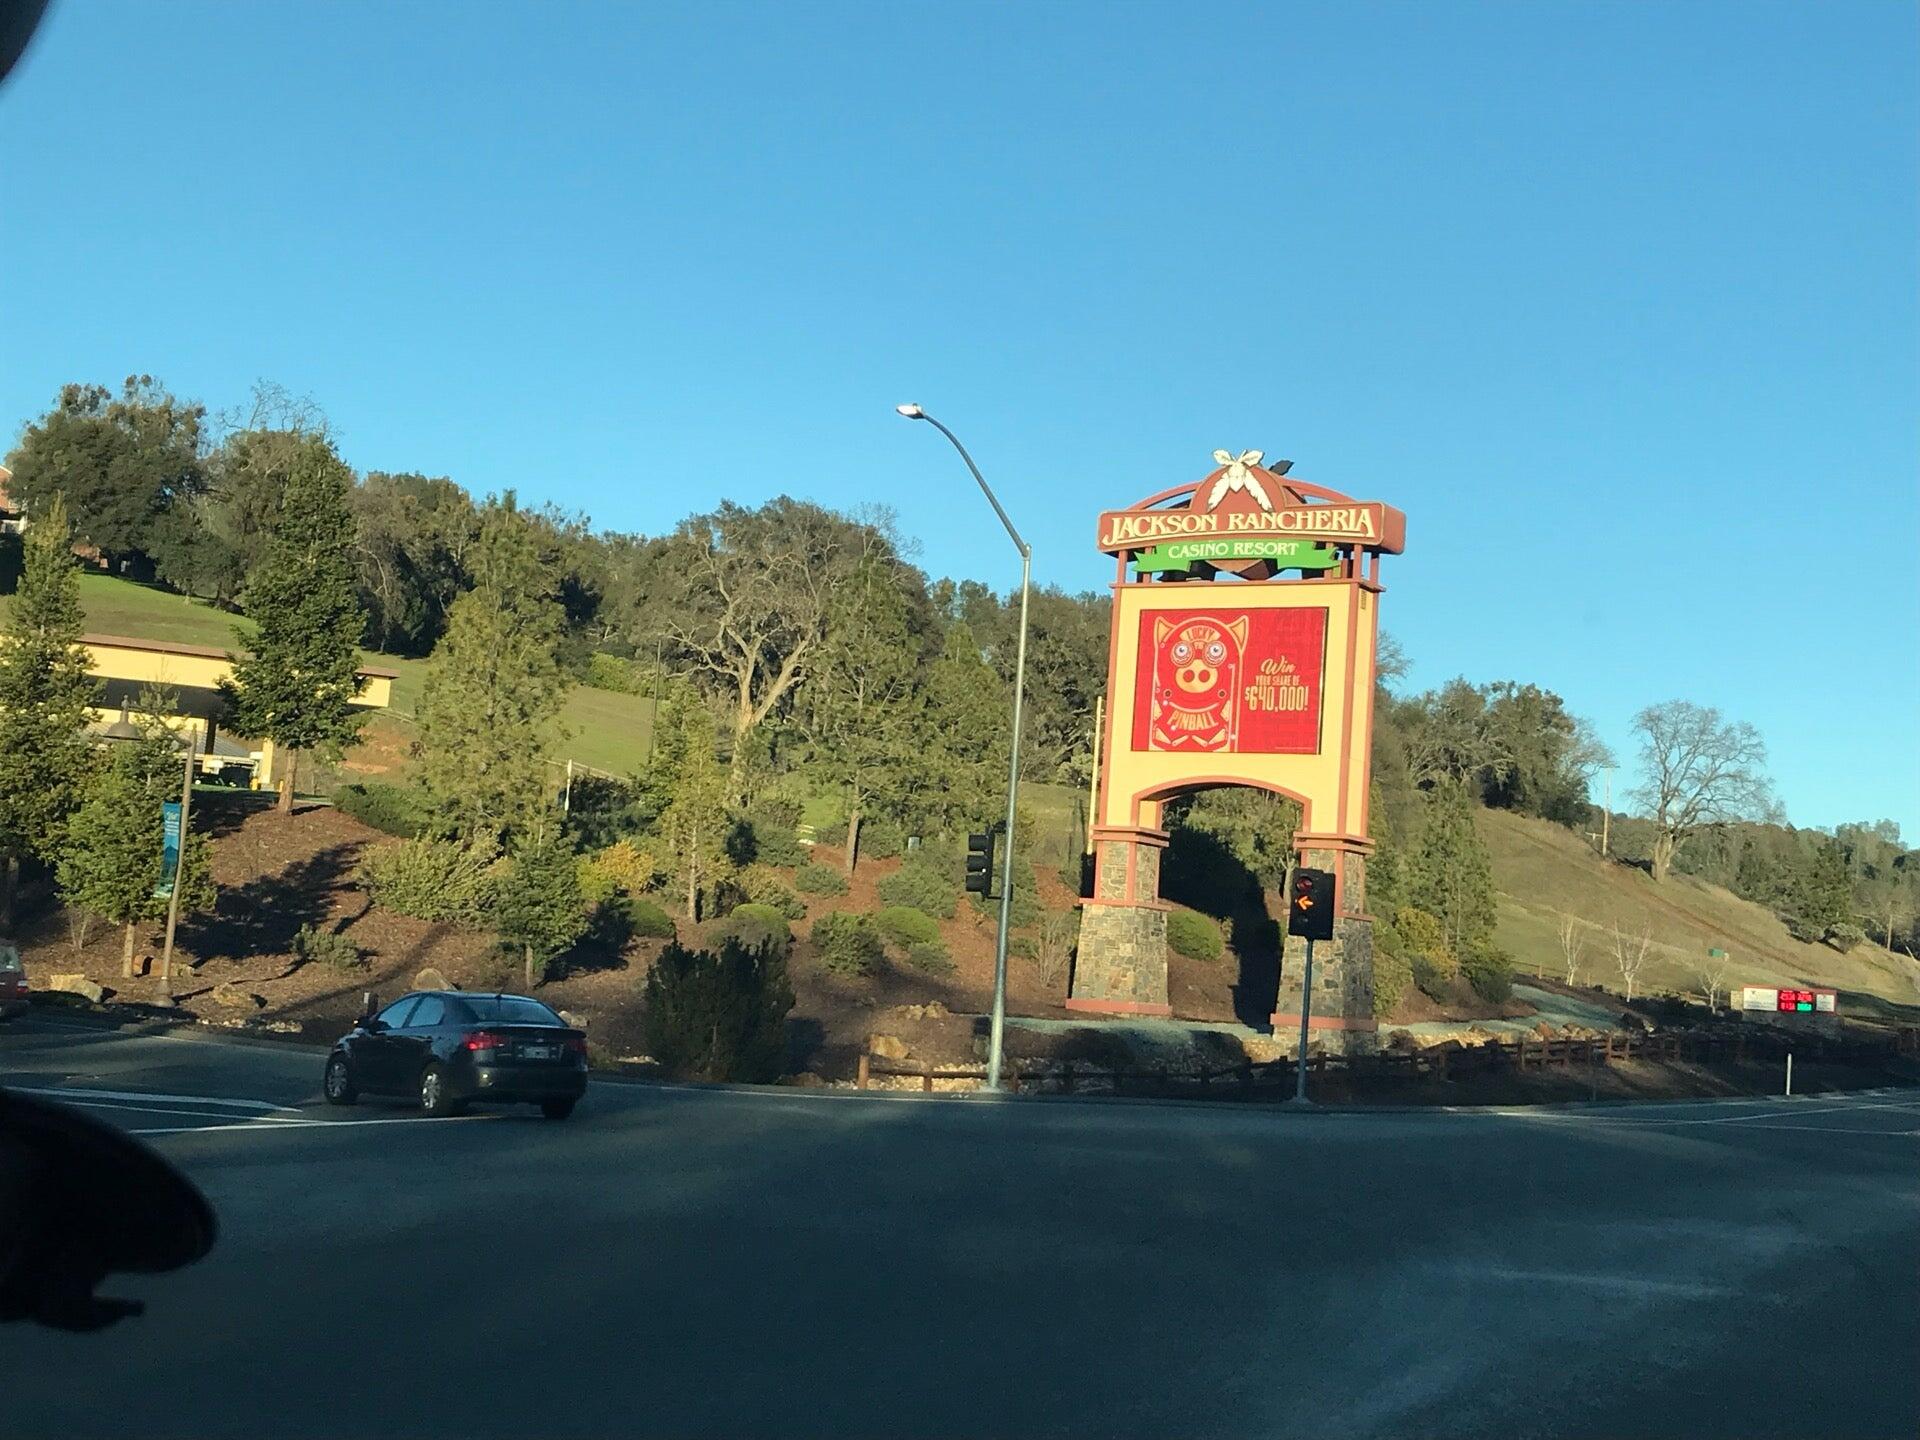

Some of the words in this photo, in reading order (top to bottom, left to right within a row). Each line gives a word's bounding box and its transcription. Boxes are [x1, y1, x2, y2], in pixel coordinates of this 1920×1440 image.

[1102, 514, 1218, 546] JACKSON
[1228, 508, 1376, 538] RANCHERIA
[1168, 541, 1229, 559] CASINO
[1233, 541, 1300, 557] RESORT
[1261, 655, 1296, 675] Win
[1245, 686, 1309, 712] $640,000!
[1167, 710, 1219, 730] PINBALL
